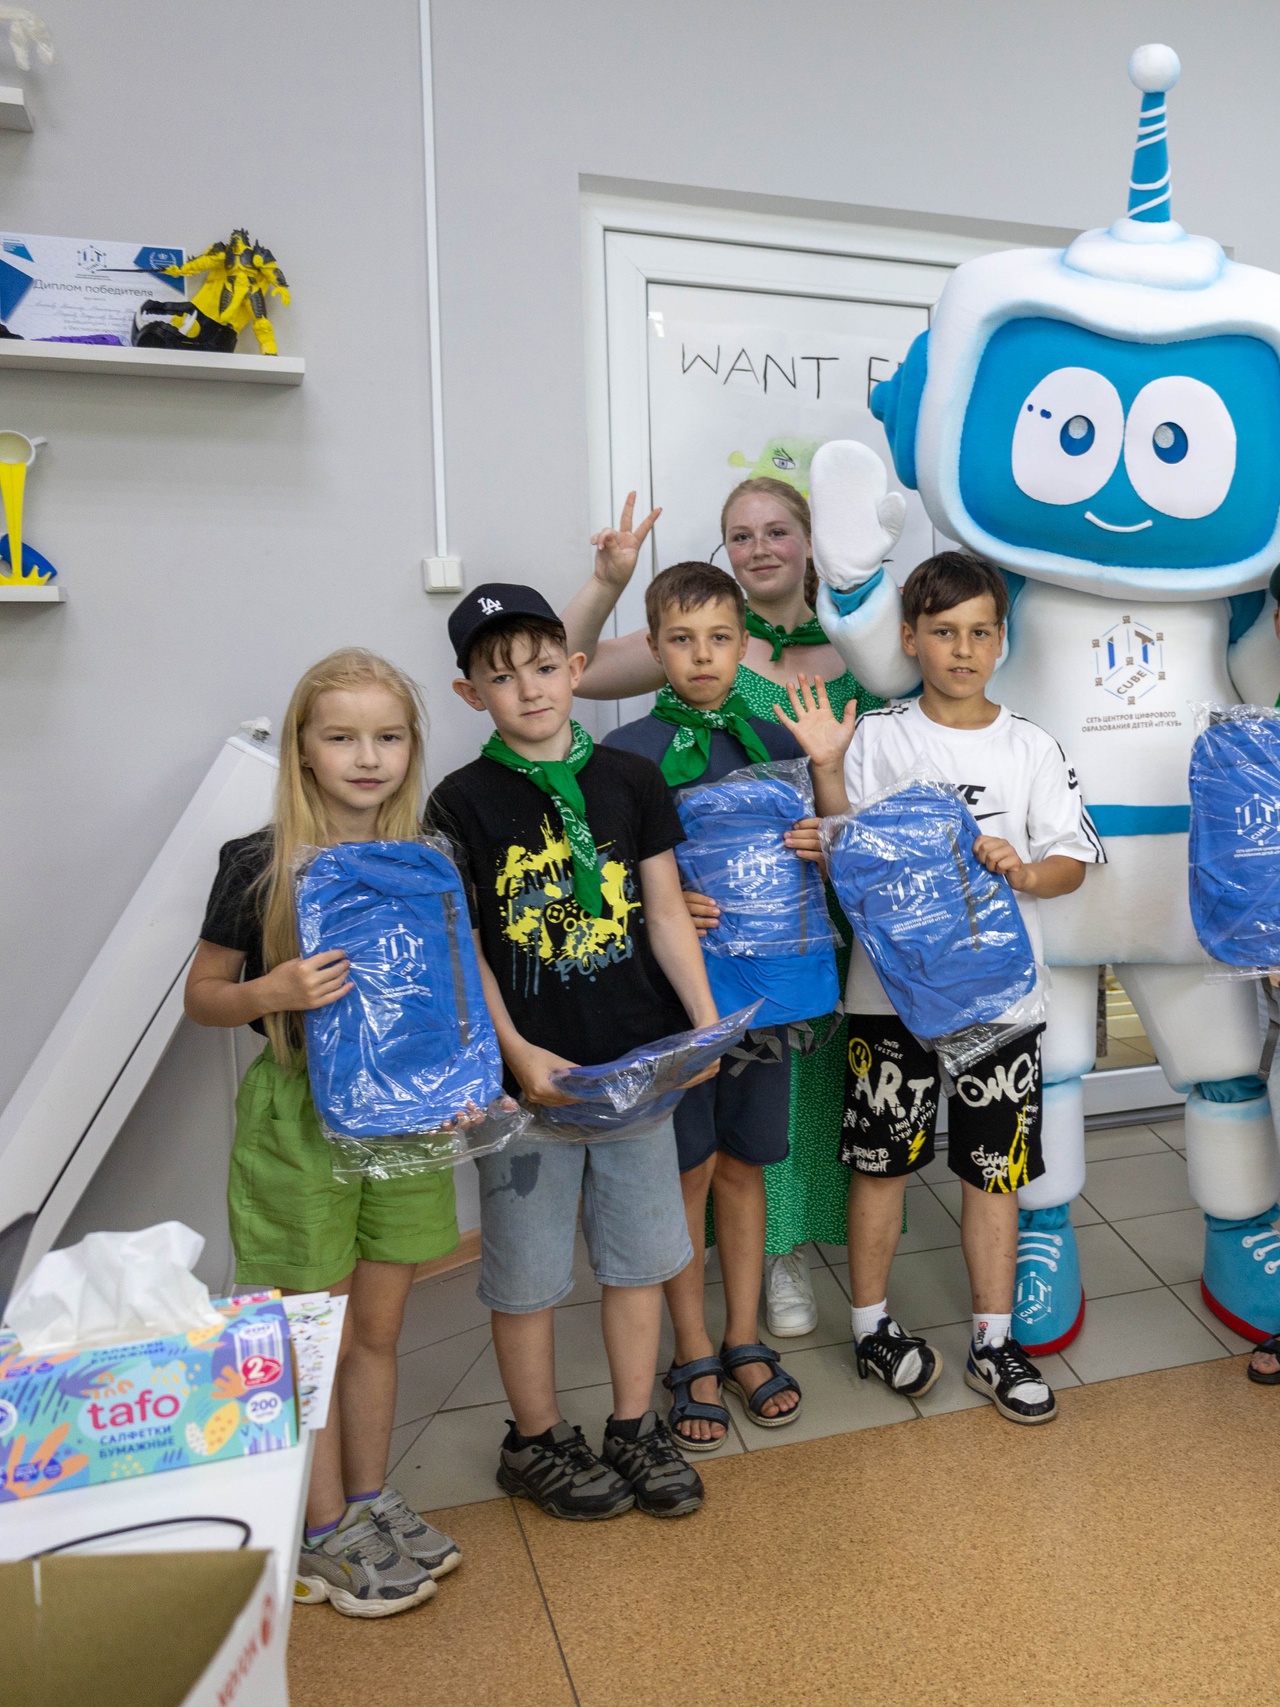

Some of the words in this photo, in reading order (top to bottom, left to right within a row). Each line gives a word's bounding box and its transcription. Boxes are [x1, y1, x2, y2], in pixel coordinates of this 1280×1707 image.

[33, 279, 82, 292] Диплом
[85, 285, 153, 297] победителя
[681, 342, 840, 400] WANT
[477, 597, 503, 615] LA
[1116, 670, 1147, 695] CUBE
[1081, 723, 1130, 732] ОБРАЗОВАНИЯ
[1131, 720, 1153, 729] ДЕТЕЙ
[1086, 716, 1102, 724] СЕТЬ
[1102, 713, 1133, 723] ЦЕНТРОВ
[1135, 711, 1176, 720] ЦИФРОВОГО
[505, 856, 575, 899] GAMIN
[556, 935, 634, 983] POWER
[874, 1043, 904, 1059] CULTURE
[854, 1061, 935, 1122] ART
[1020, 1303, 1043, 1318] CUBE
[247, 1357, 265, 1379] 2
[87, 1389, 180, 1431] tafo
[250, 1398, 278, 1412] 200
[100, 1425, 172, 1446] САЛФЕТКИ
[99, 1436, 175, 1459] БУМАЖНЫЕ
